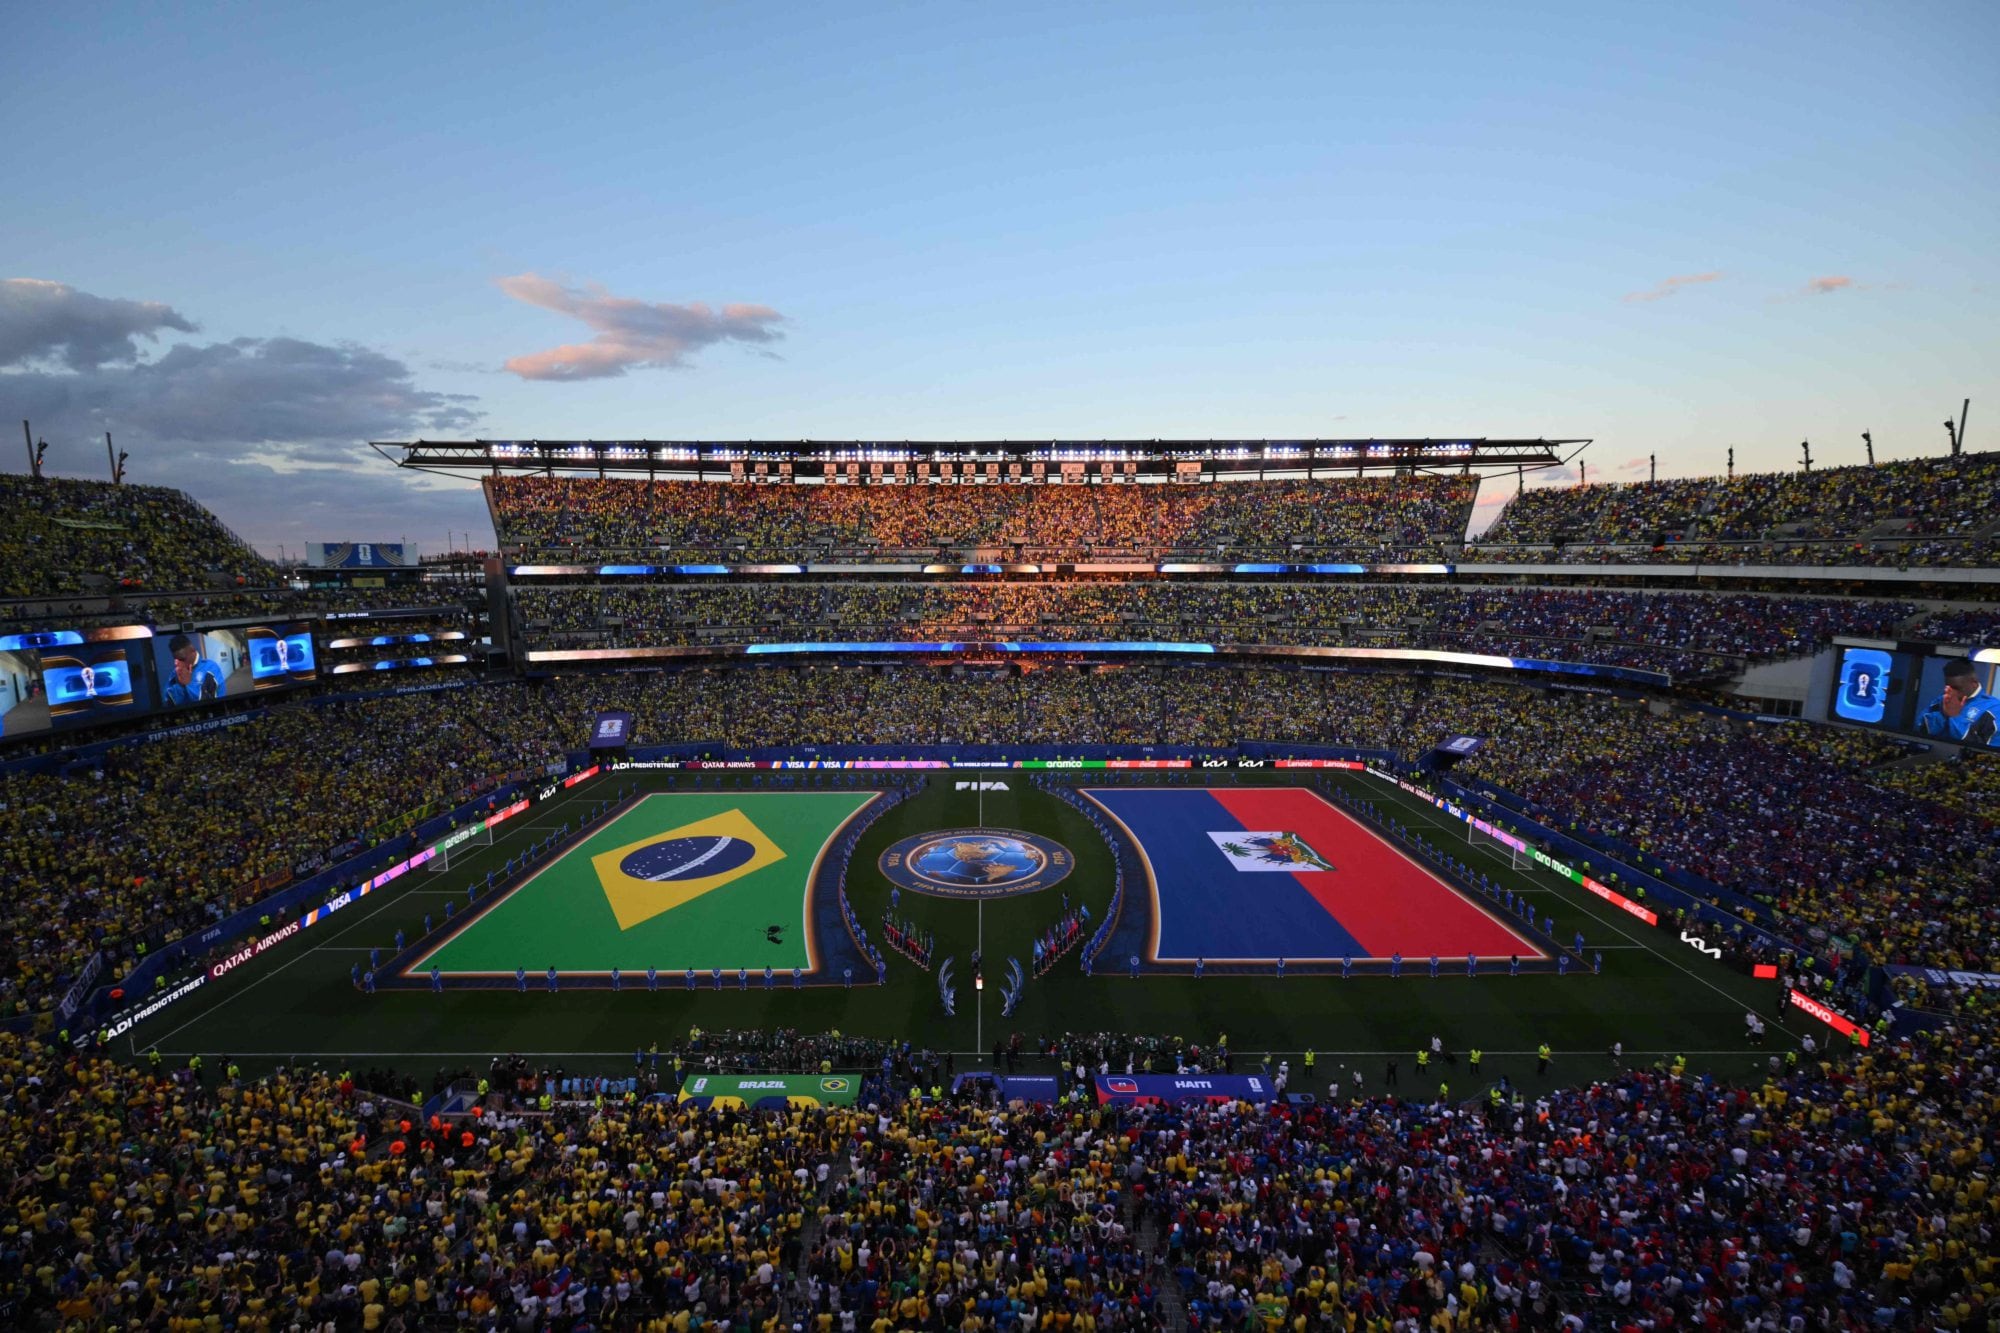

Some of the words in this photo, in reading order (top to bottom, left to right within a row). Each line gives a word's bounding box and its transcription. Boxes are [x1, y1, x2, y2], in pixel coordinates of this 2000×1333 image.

[396, 681, 465, 694] PHILADELPHIA
[1551, 682, 1612, 695] PHILADELPHIA
[170, 724, 202, 736] WORLD
[203, 721, 220, 730] CUP
[1287, 760, 1312, 768] Lenovo
[955, 781, 1010, 791] FIFA
[1448, 804, 1461, 818] VISA
[1534, 851, 1572, 878] aramco
[912, 881, 936, 892] FIFA
[937, 887, 978, 895] WORLD
[326, 893, 351, 912] VISA
[202, 929, 221, 943] FIFA
[213, 947, 253, 977] QATAR
[256, 921, 299, 954] AIRWAYS
[106, 1017, 132, 1041] ADI
[134, 975, 206, 1023] PREDICTSTREET
[738, 1081, 786, 1089] BRAZIL
[1174, 1080, 1212, 1089] HAITI
